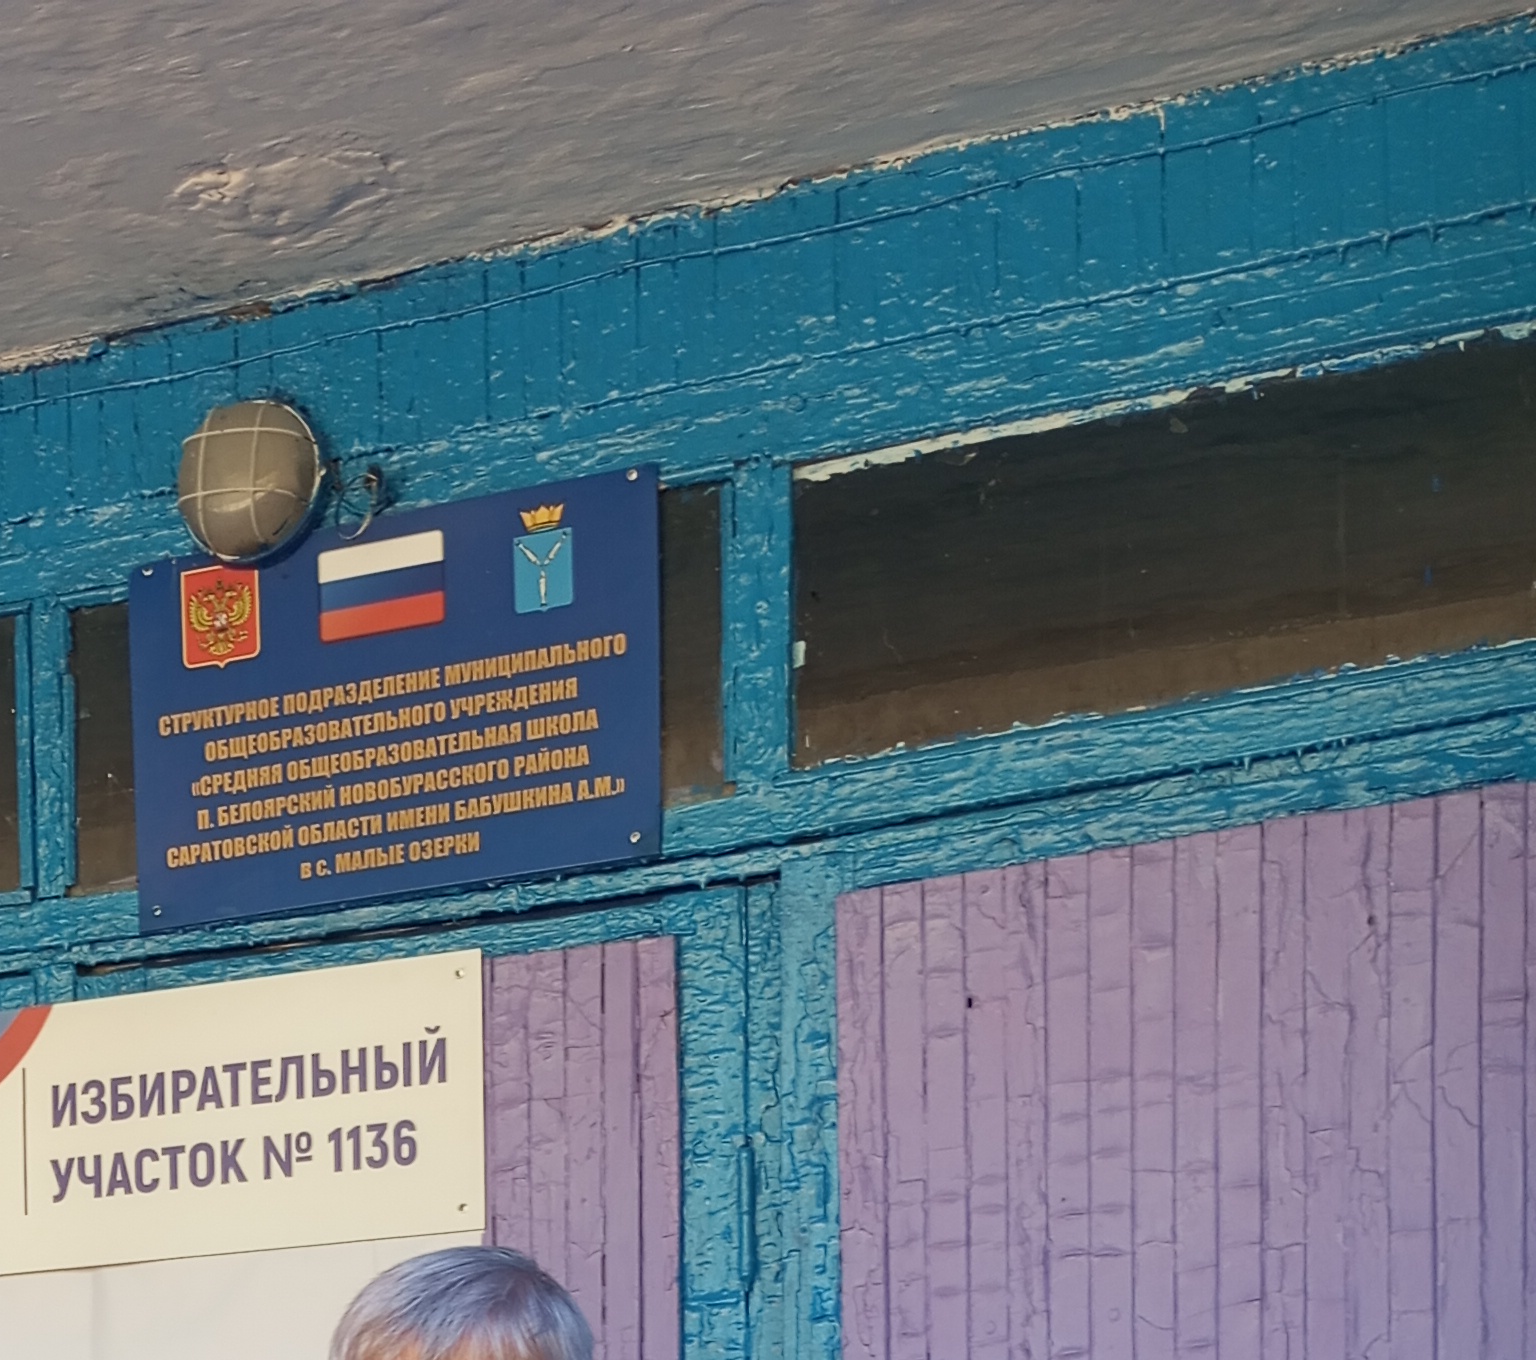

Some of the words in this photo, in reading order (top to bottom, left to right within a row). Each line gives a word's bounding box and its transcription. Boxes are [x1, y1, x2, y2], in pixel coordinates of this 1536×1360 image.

[159, 697, 279, 736] СТРУКТУРНОЕ
[283, 667, 441, 715] ПОДРАЗДЕЛЕНИЕ
[444, 633, 627, 686] МУНИЦИПАЛЬНОГО
[205, 701, 446, 762] ОБЩЕОБРАЗОВАТЕЛЬНОГО
[450, 677, 578, 719] УЧРЕЖДЕНИЯ
[192, 764, 283, 797] «СРЕДНЯЯ
[287, 722, 522, 782] ОБЩЕОБРАЗОВАТЕЛЬНАЯ
[526, 708, 599, 741] ШКОЛА
[217, 785, 335, 827] БЕЛОЯРСКИЙ
[340, 758, 509, 806] НОВОБУРАССКОГО
[514, 745, 590, 777] РАЙОНА
[166, 825, 294, 869] САРАТОВСКОЙ
[298, 814, 382, 847] ОБЛАСТИ
[386, 803, 450, 832] ИМЕНИ
[455, 782, 574, 821] БАБУШКИНА
[335, 843, 405, 874] МАЛЫЕ
[409, 831, 480, 862] ОЗЕРКИ
[50, 1025, 449, 1128] ИЗБИРАТЕЛЬНЫЙ
[50, 1138, 248, 1203] УЧАСТОК
[263, 1131, 313, 1179] №
[327, 1119, 418, 1173] 1136
